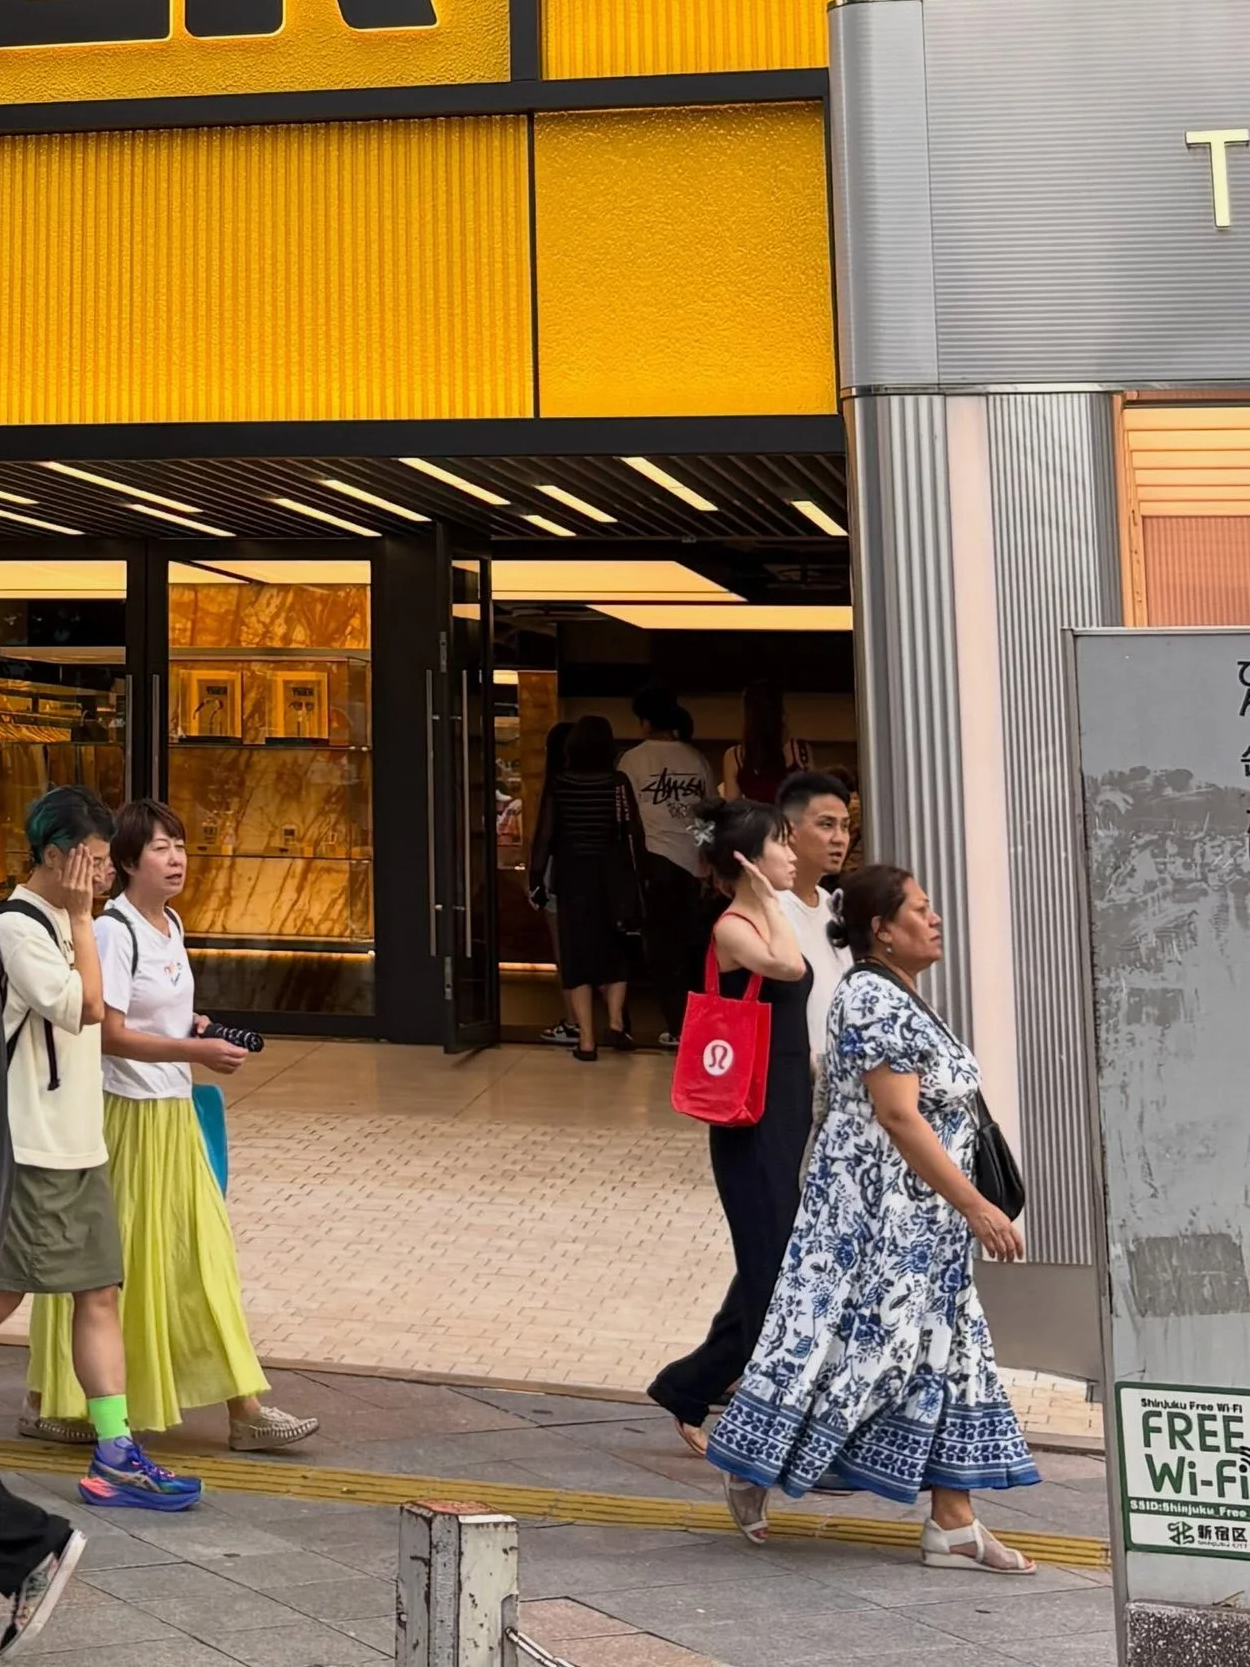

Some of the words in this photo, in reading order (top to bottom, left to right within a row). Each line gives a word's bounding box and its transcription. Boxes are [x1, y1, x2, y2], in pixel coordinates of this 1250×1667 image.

[1141, 1398, 1187, 1410] Shinjuku
[1189, 1401, 1214, 1411] Free
[1142, 1410, 1244, 1454] FREE
[1144, 1453, 1250, 1500] Wi-Fi
[1197, 1524, 1248, 1542] 新宿区
